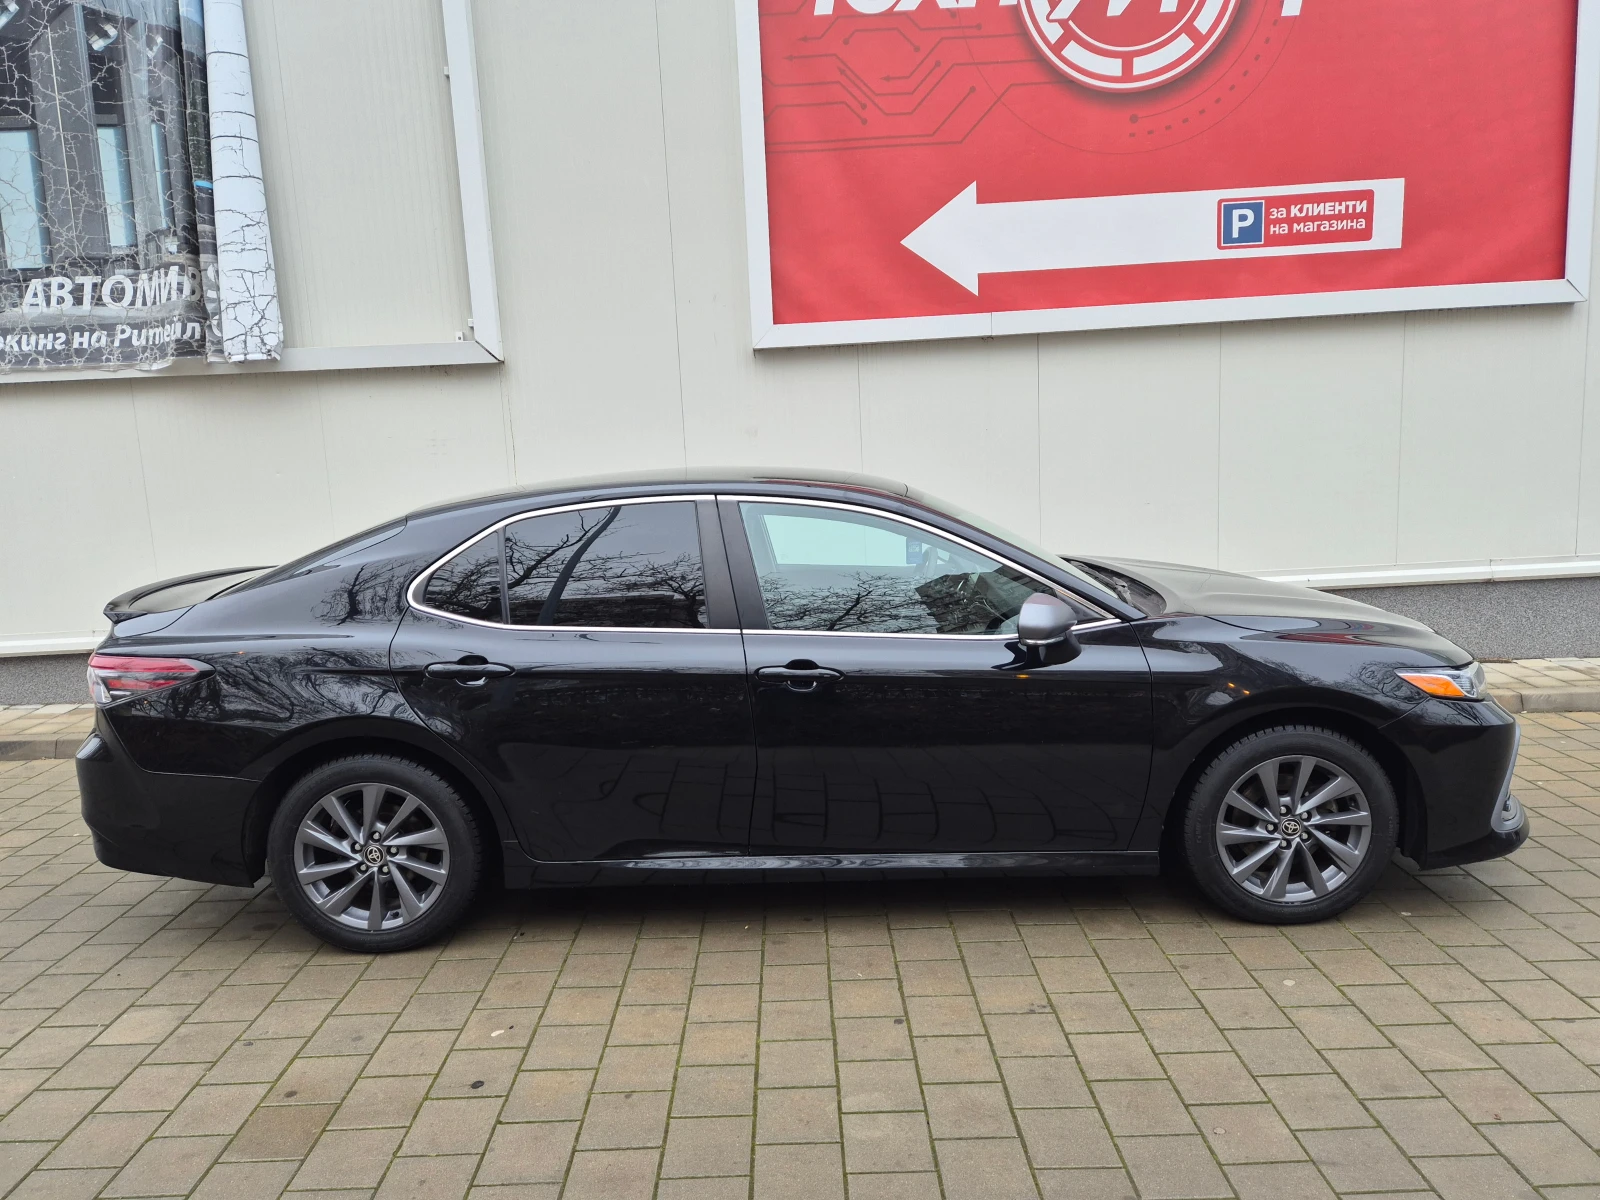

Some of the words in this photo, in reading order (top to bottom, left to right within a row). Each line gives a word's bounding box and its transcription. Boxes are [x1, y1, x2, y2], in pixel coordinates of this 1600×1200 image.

[1269, 207, 1287, 219] за
[1290, 200, 1368, 218] КЛИЕНТИ
[1232, 208, 1255, 239] P
[1269, 223, 1289, 235] на
[1292, 218, 1366, 234] магазина
[73, 330, 108, 349] на
